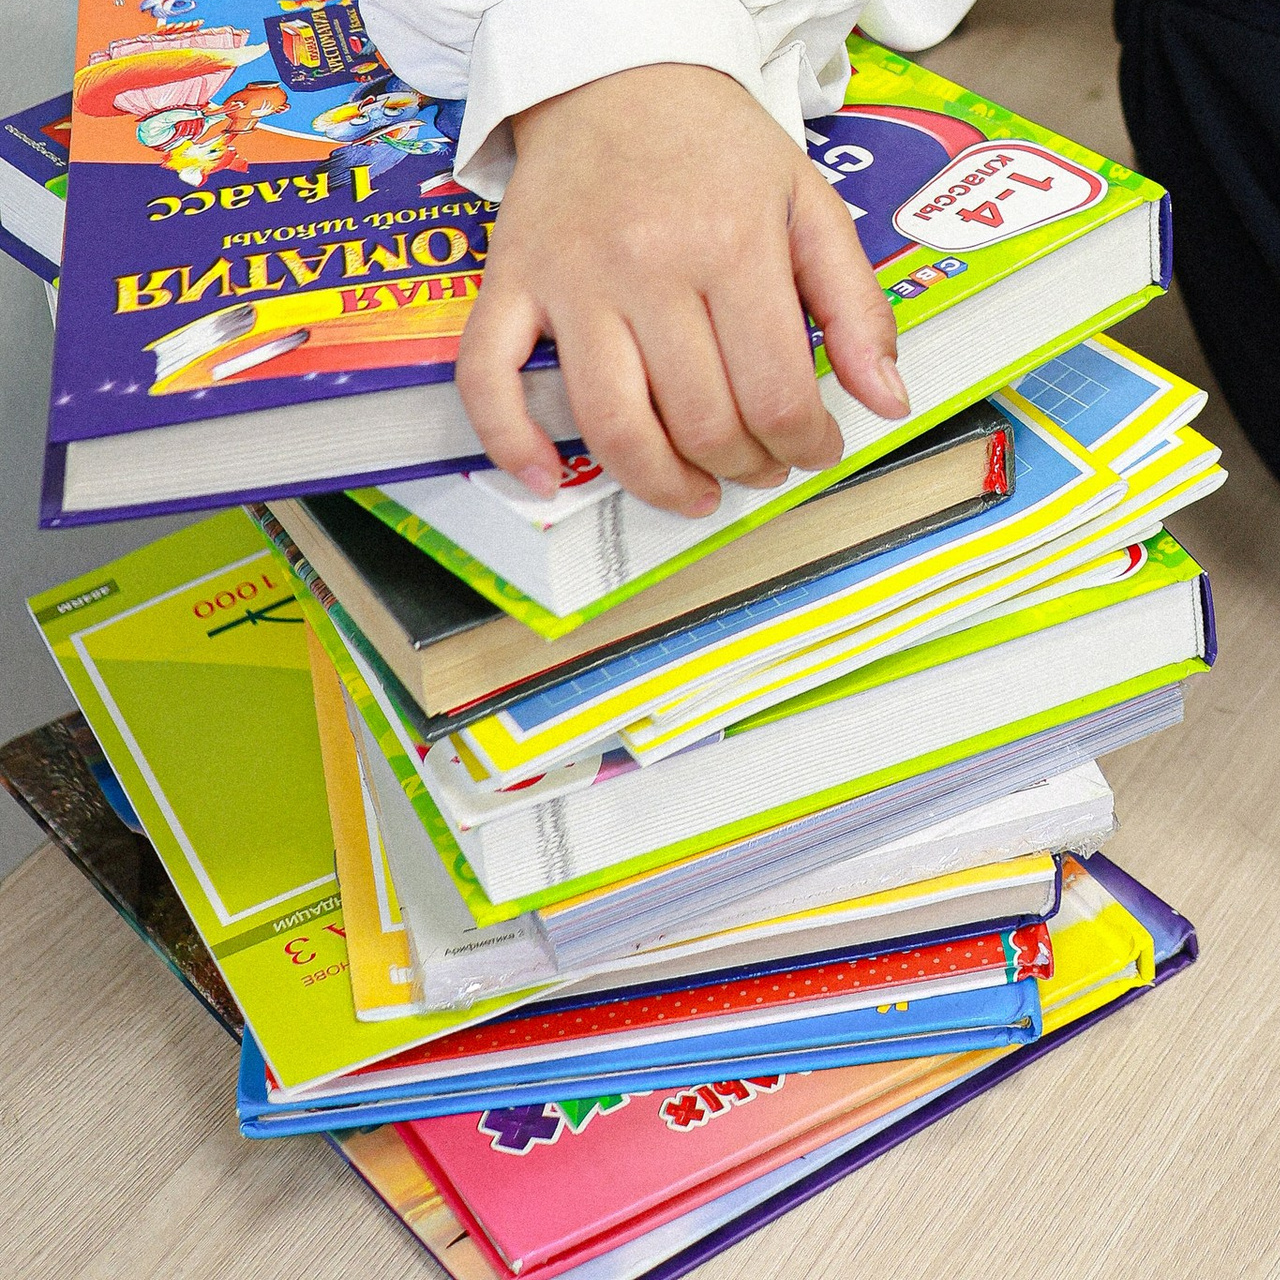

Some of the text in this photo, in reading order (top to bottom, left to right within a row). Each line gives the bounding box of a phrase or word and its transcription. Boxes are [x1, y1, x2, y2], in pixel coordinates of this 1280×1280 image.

[147, 164, 380, 221] 1 класс
[914, 154, 1014, 221] классы
[956, 172, 1054, 228] 1-4
[222, 217, 358, 249] школы
[192, 574, 277, 619] 1000
[284, 937, 316, 965] 3
[444, 933, 515, 956] Арифметика
